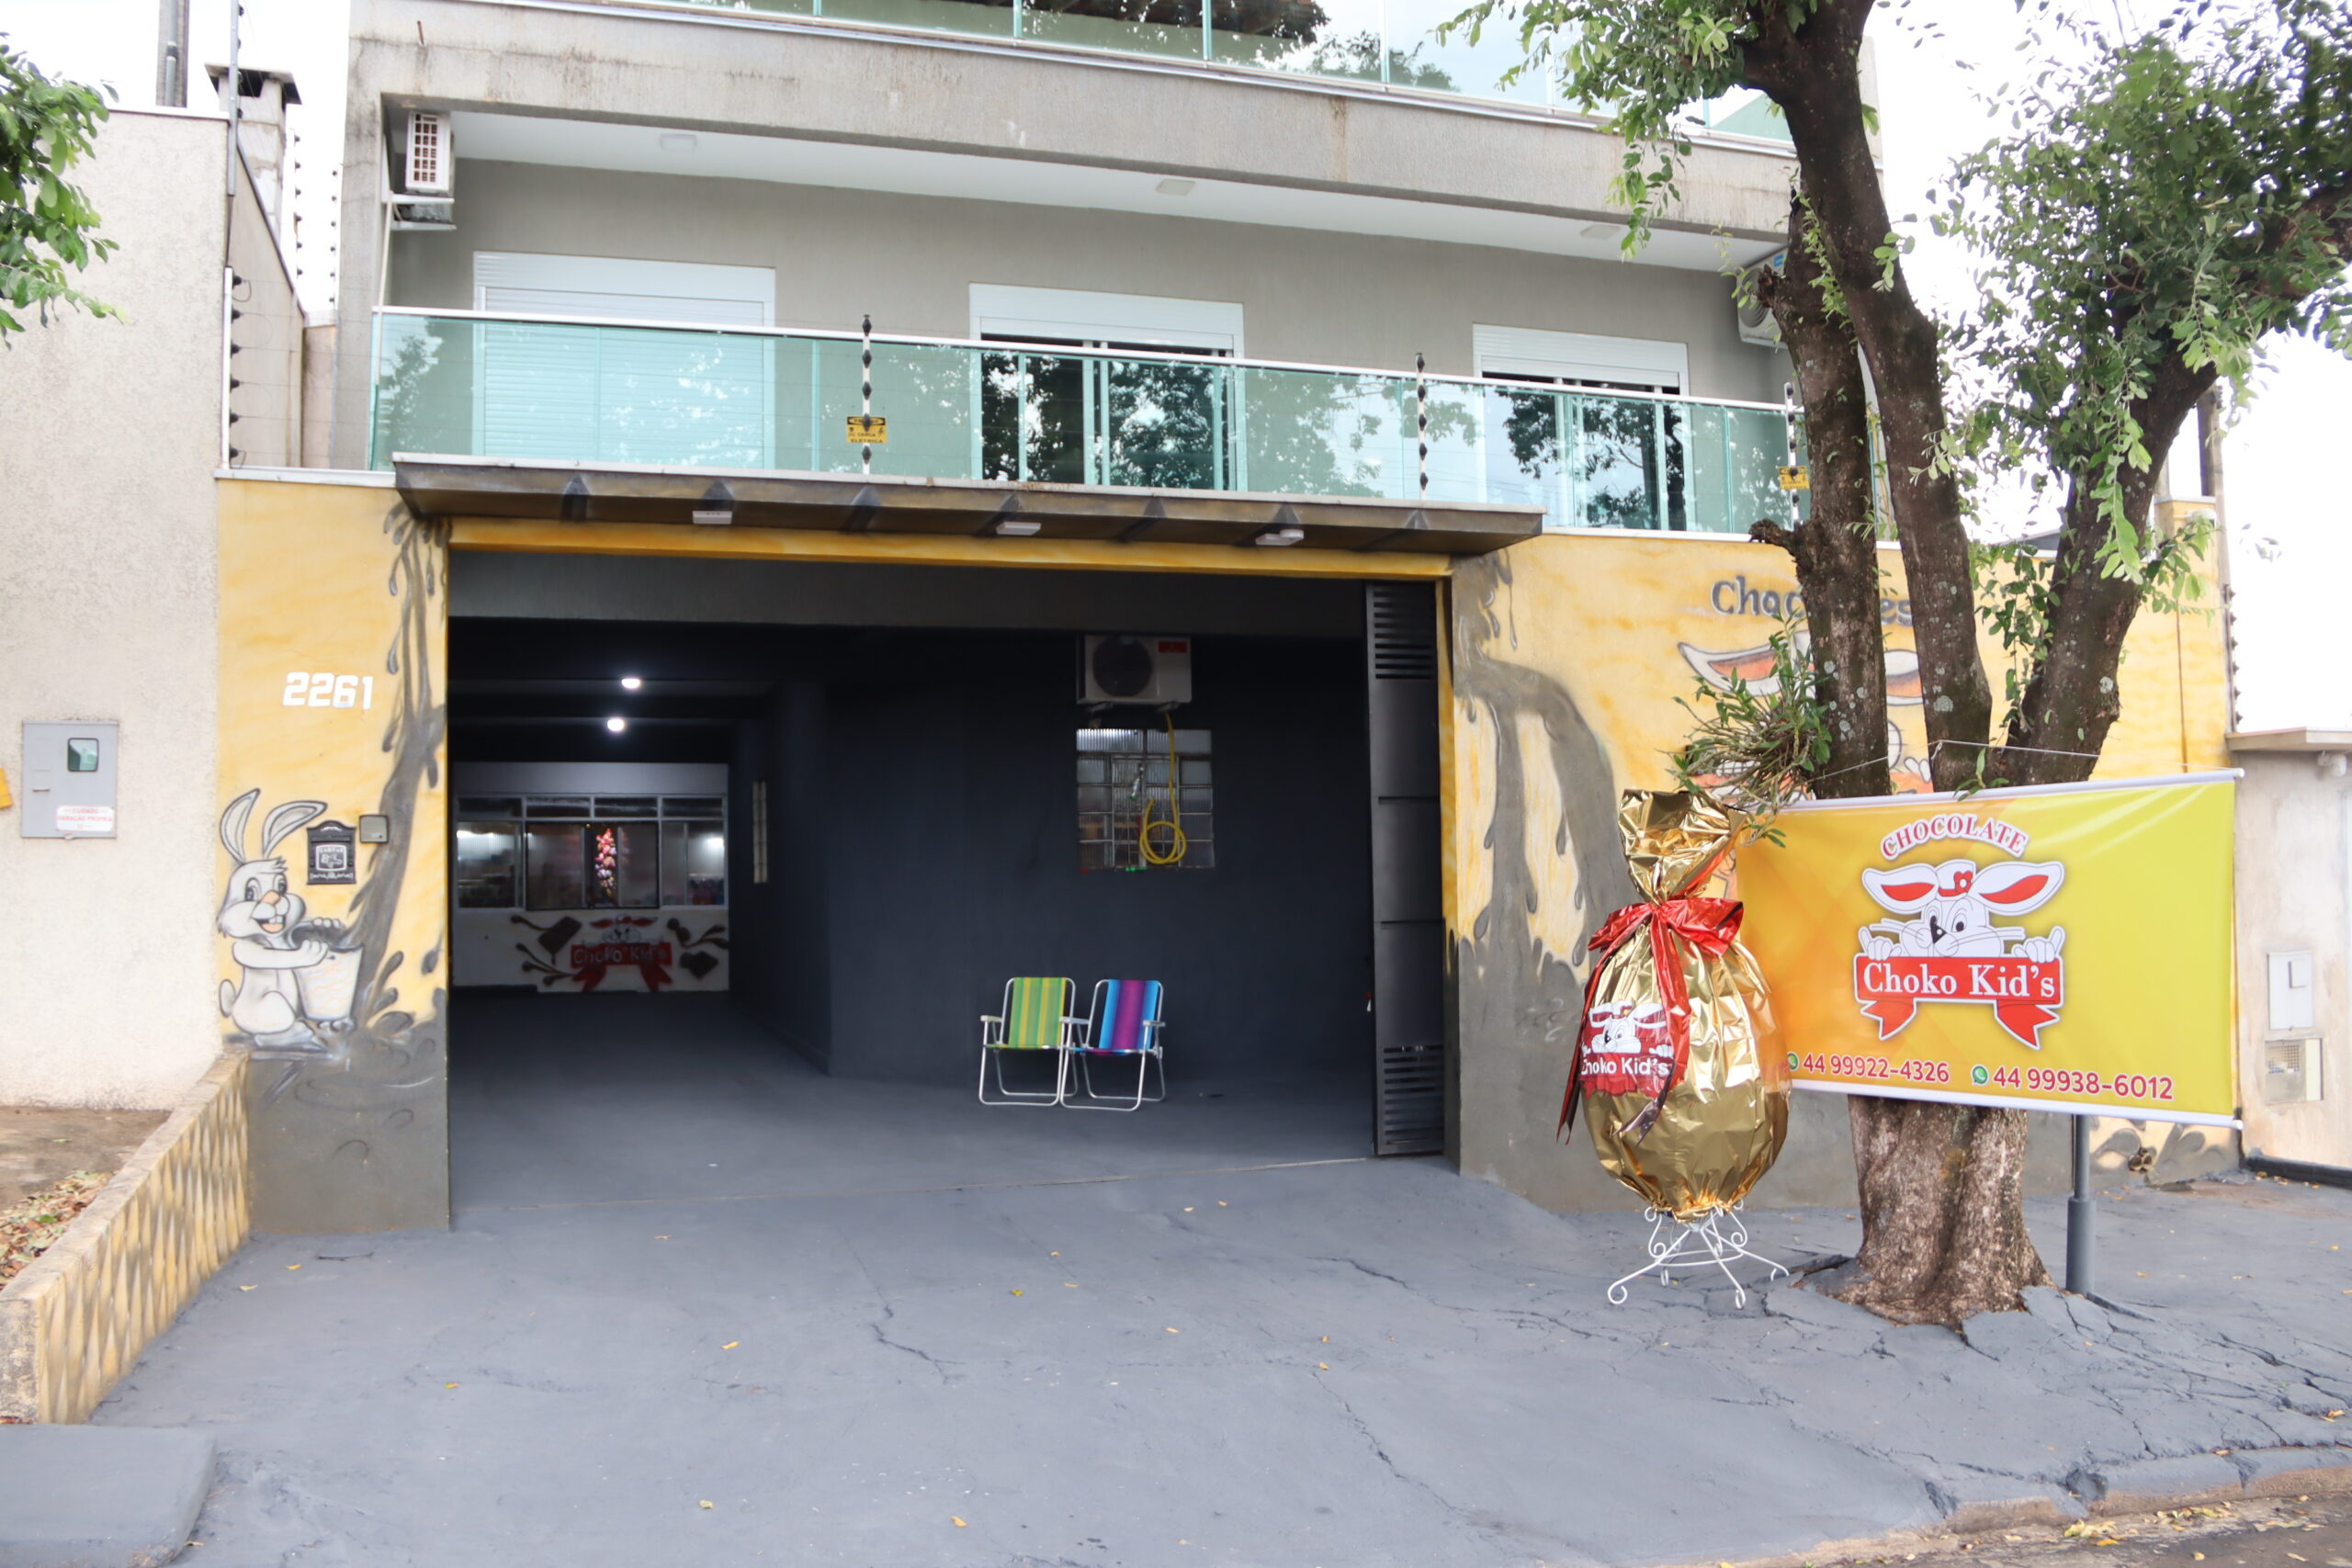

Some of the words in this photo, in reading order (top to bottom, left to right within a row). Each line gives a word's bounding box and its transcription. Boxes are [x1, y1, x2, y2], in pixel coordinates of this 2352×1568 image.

[282, 671, 374, 710] 2261
[1883, 815, 2027, 857] CHOCOLATE
[1863, 963, 1957, 995] Choko
[1968, 964, 2055, 998] Kid's
[1621, 1057, 1670, 1076] Kid's
[1803, 1054, 1826, 1073] 44
[1830, 1055, 1950, 1083] 99922-4326
[1993, 1066, 2020, 1088] 44
[2027, 1067, 2173, 1100] 99938-6012
